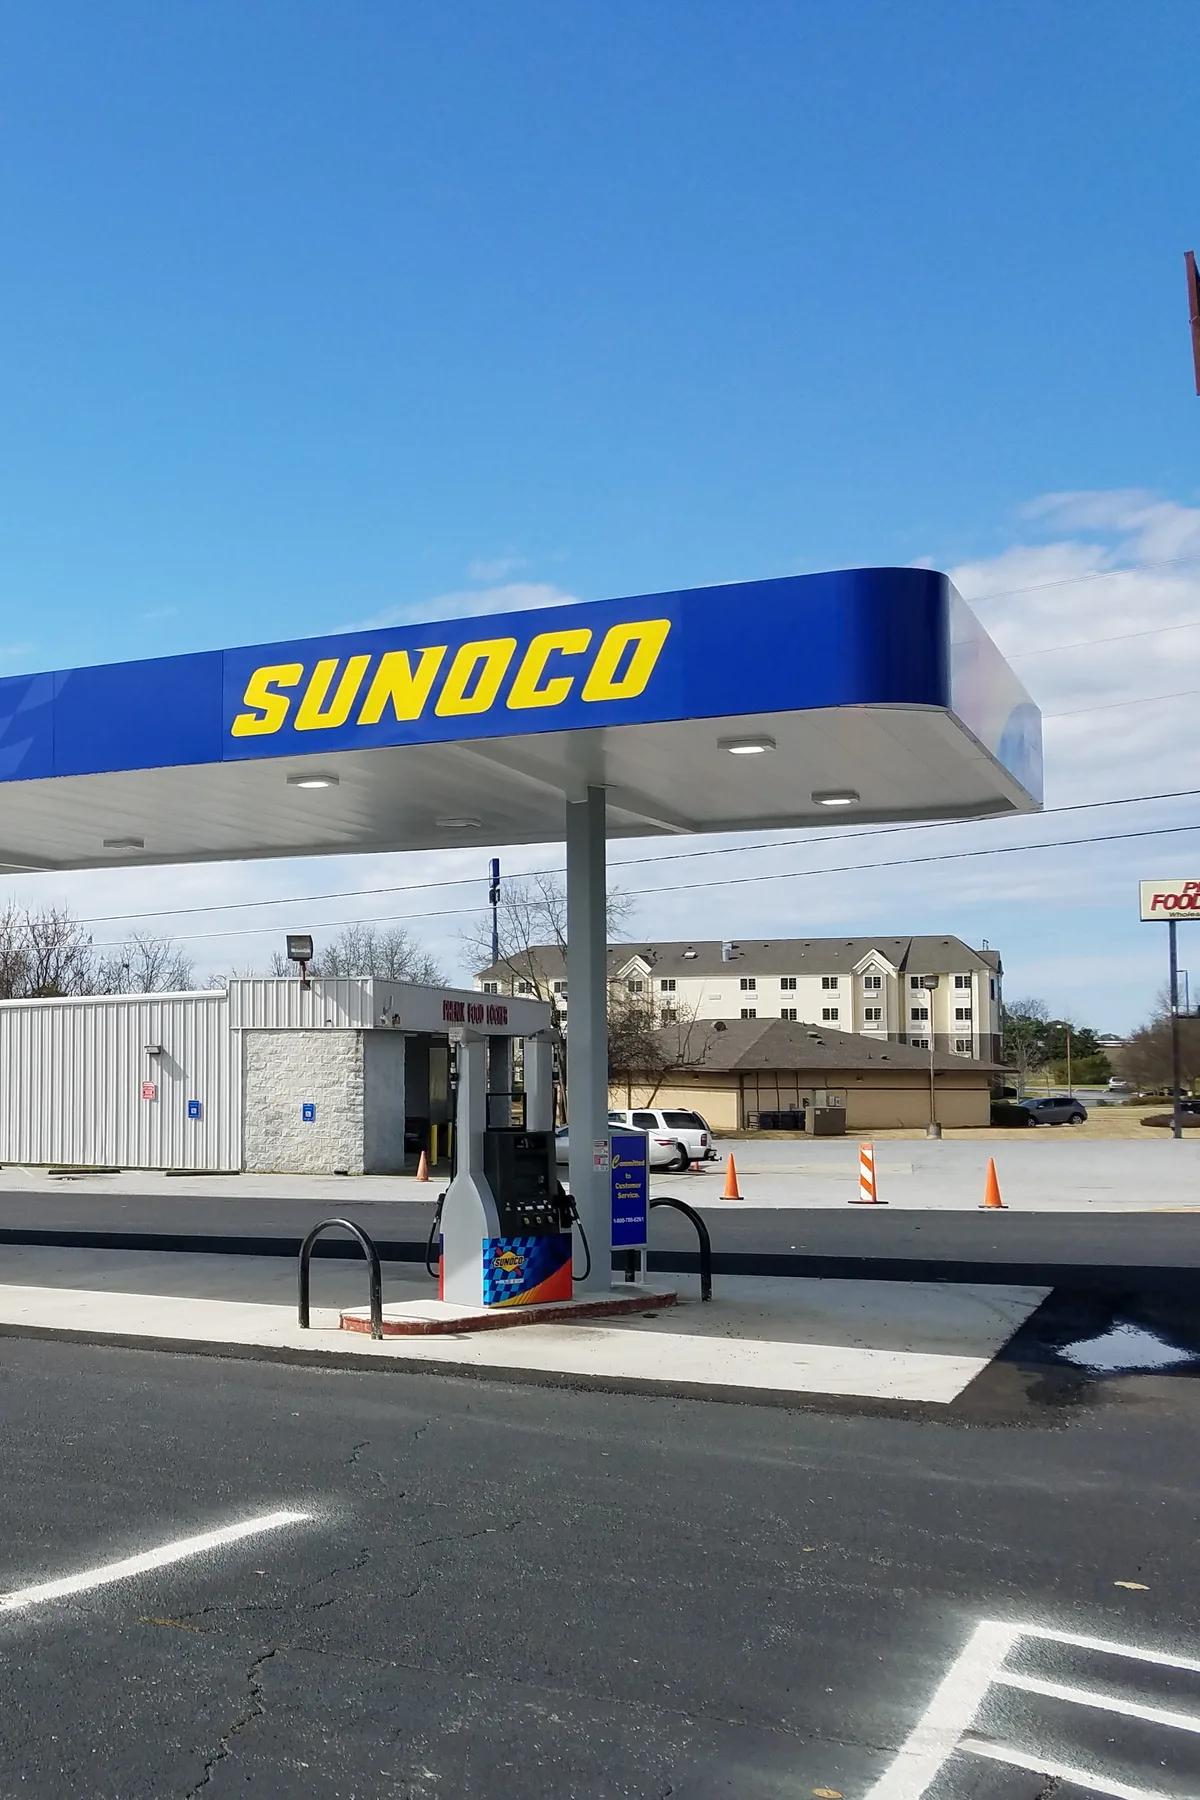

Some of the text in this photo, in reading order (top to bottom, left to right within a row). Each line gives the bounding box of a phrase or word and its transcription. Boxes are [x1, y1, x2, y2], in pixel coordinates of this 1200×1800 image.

[231, 619, 671, 737] SUNOCO
[467, 1003, 484, 1024] FOOD
[612, 1154, 645, 1168] Committed
[494, 1256, 523, 1267] SUNOCO
